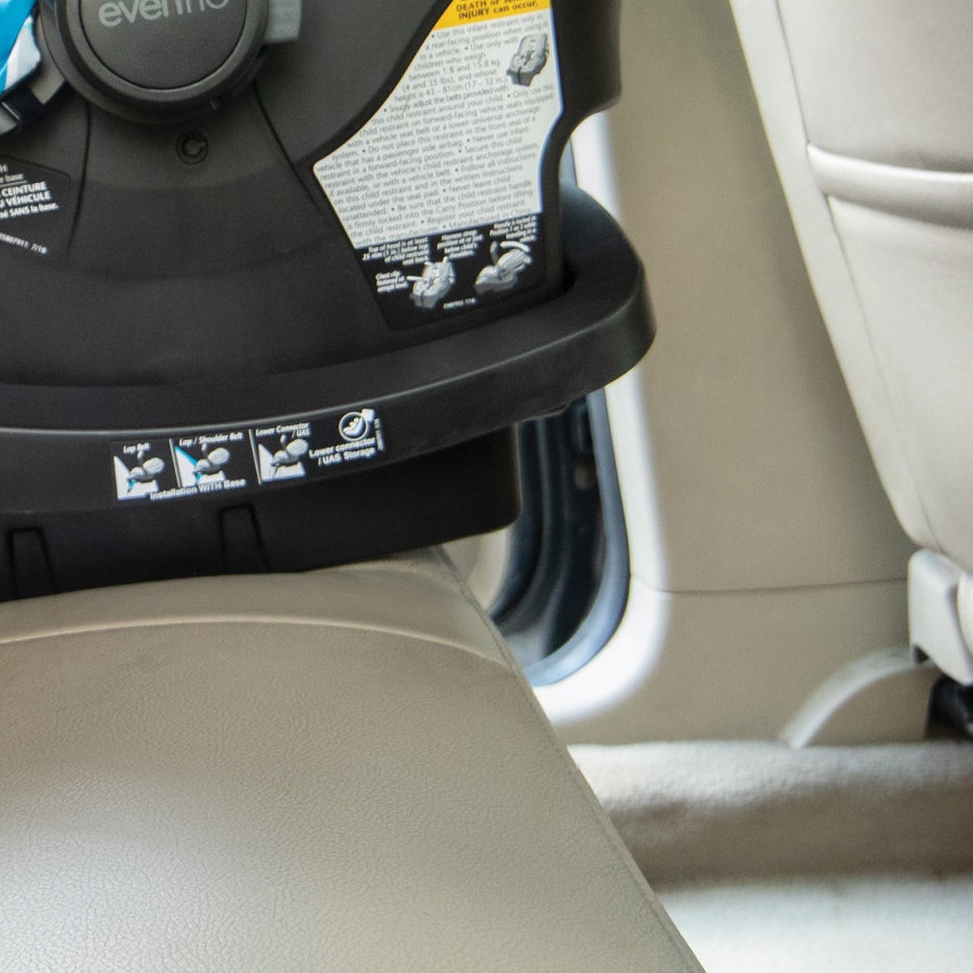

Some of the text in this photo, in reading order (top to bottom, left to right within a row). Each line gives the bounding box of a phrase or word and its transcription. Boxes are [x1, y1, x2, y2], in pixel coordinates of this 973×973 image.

[456, 0, 487, 12] DEATH
[458, 8, 489, 20] INJURY
[493, 5, 510, 14] can
[4, 173, 24, 182] base
[1, 181, 47, 197] CEINTURE
[6, 190, 52, 207] VÉHICULE
[9, 206, 30, 217] SANS
[31, 204, 38, 213] la
[255, 422, 309, 437] Lower Connector
[179, 438, 192, 447] Lap
[199, 433, 228, 443] Shoulder
[229, 431, 243, 440] Belt
[123, 442, 150, 454] Lap Belt
[309, 438, 376, 458] Lower connector
[323, 455, 341, 466] UAS
[344, 448, 376, 461] Storage
[150, 478, 246, 500] Installation WITH Base
